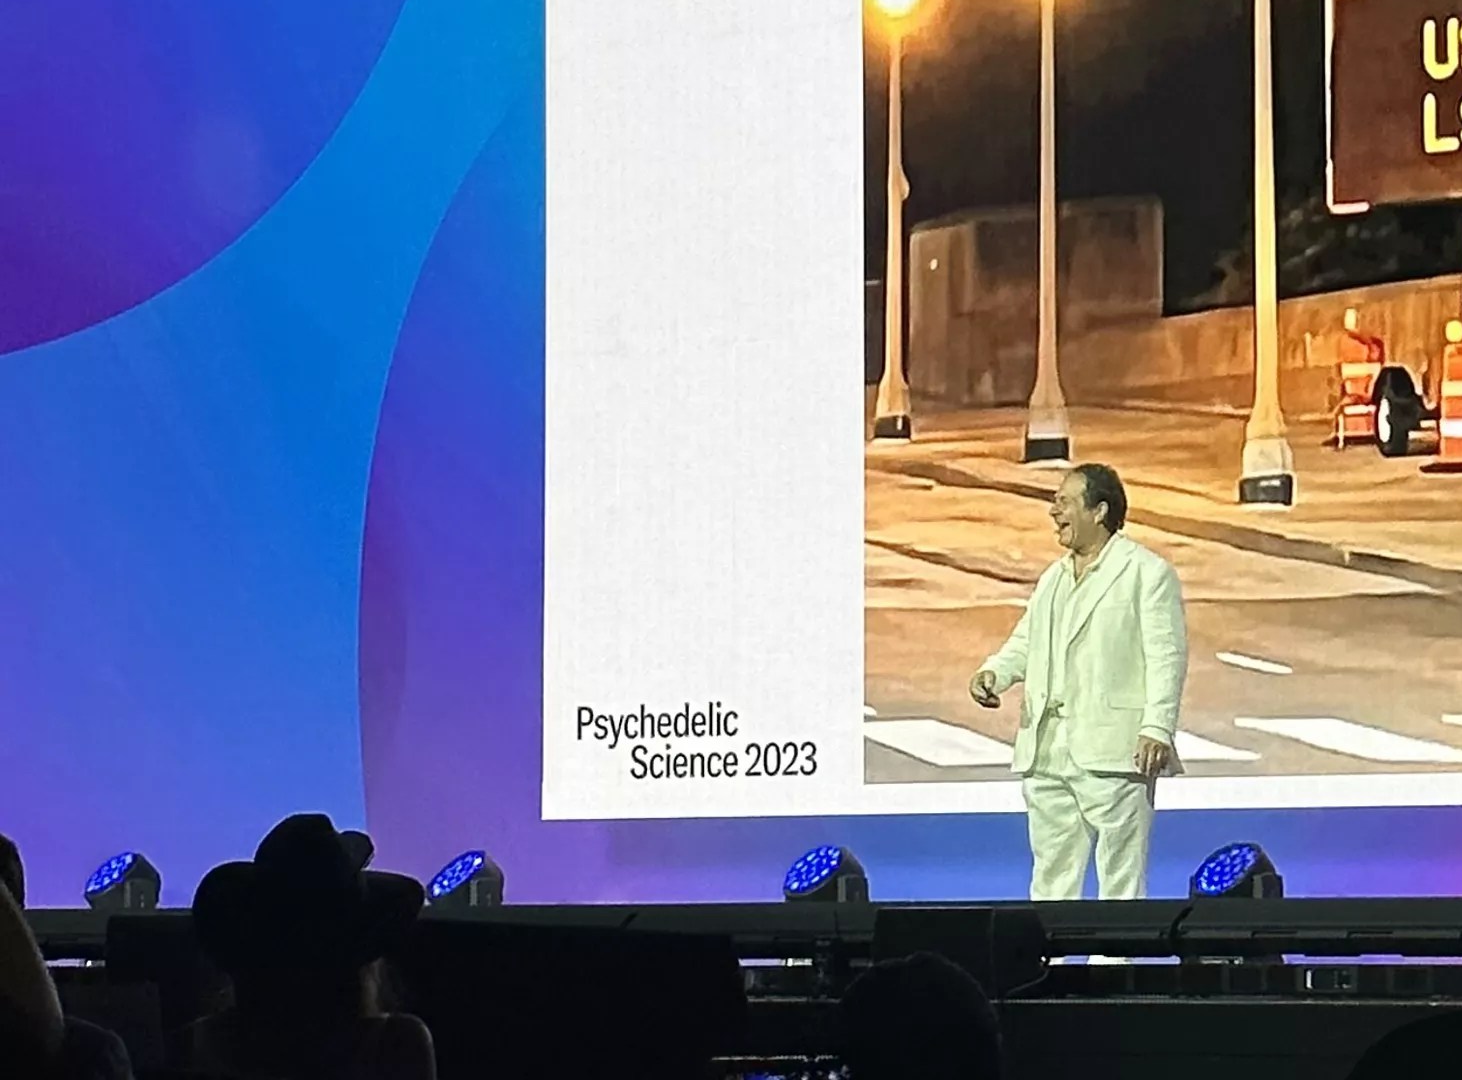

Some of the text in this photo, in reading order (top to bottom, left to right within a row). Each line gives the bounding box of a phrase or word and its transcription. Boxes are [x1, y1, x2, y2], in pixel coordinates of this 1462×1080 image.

[576, 701, 739, 749] Psychedelic
[630, 741, 818, 779] Science 2023
